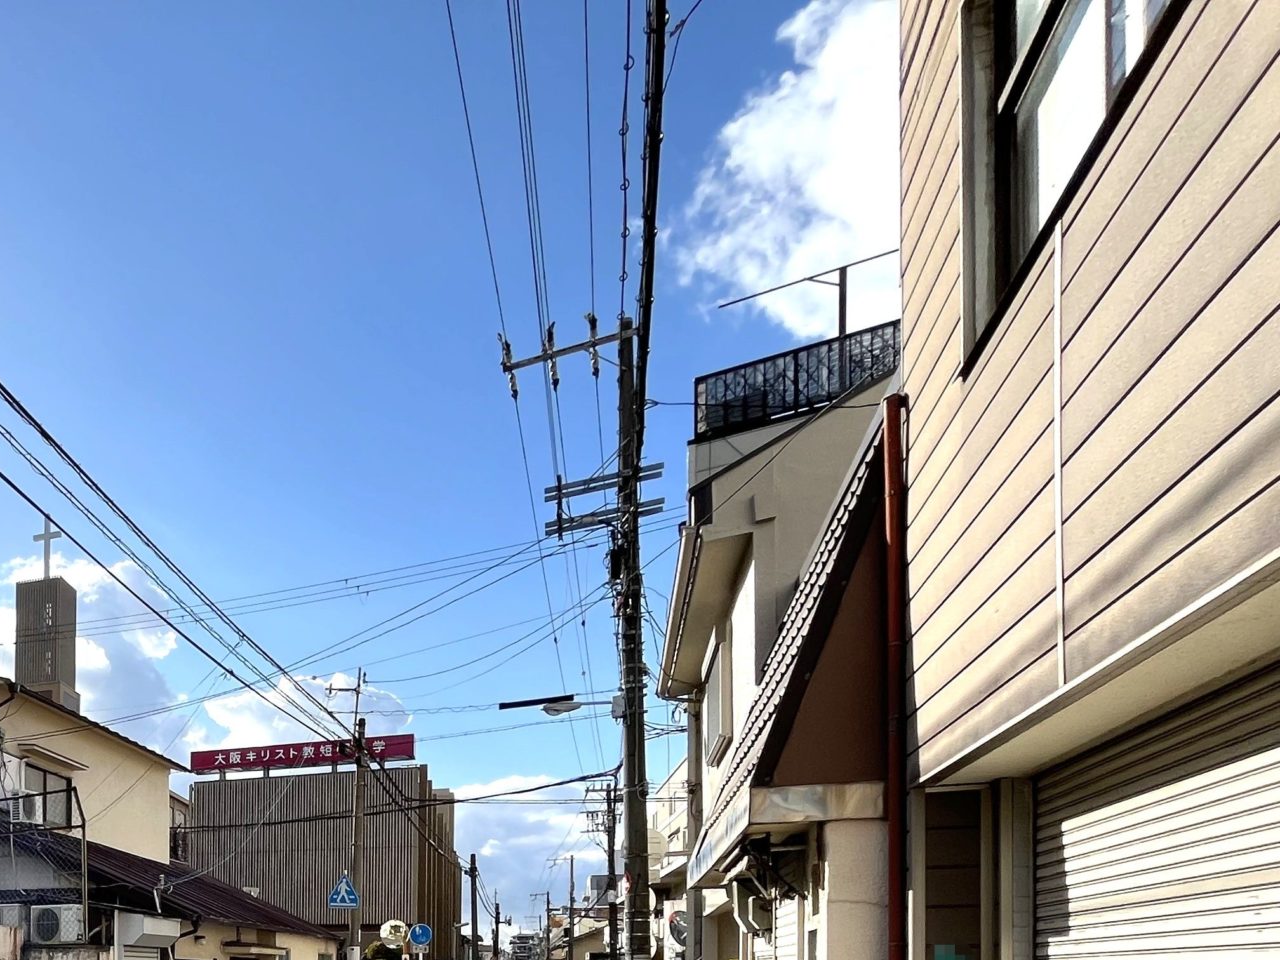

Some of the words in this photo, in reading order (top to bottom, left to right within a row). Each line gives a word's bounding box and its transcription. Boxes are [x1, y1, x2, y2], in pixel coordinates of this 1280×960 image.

[214, 740, 386, 766] 大阪キリスト教短学
